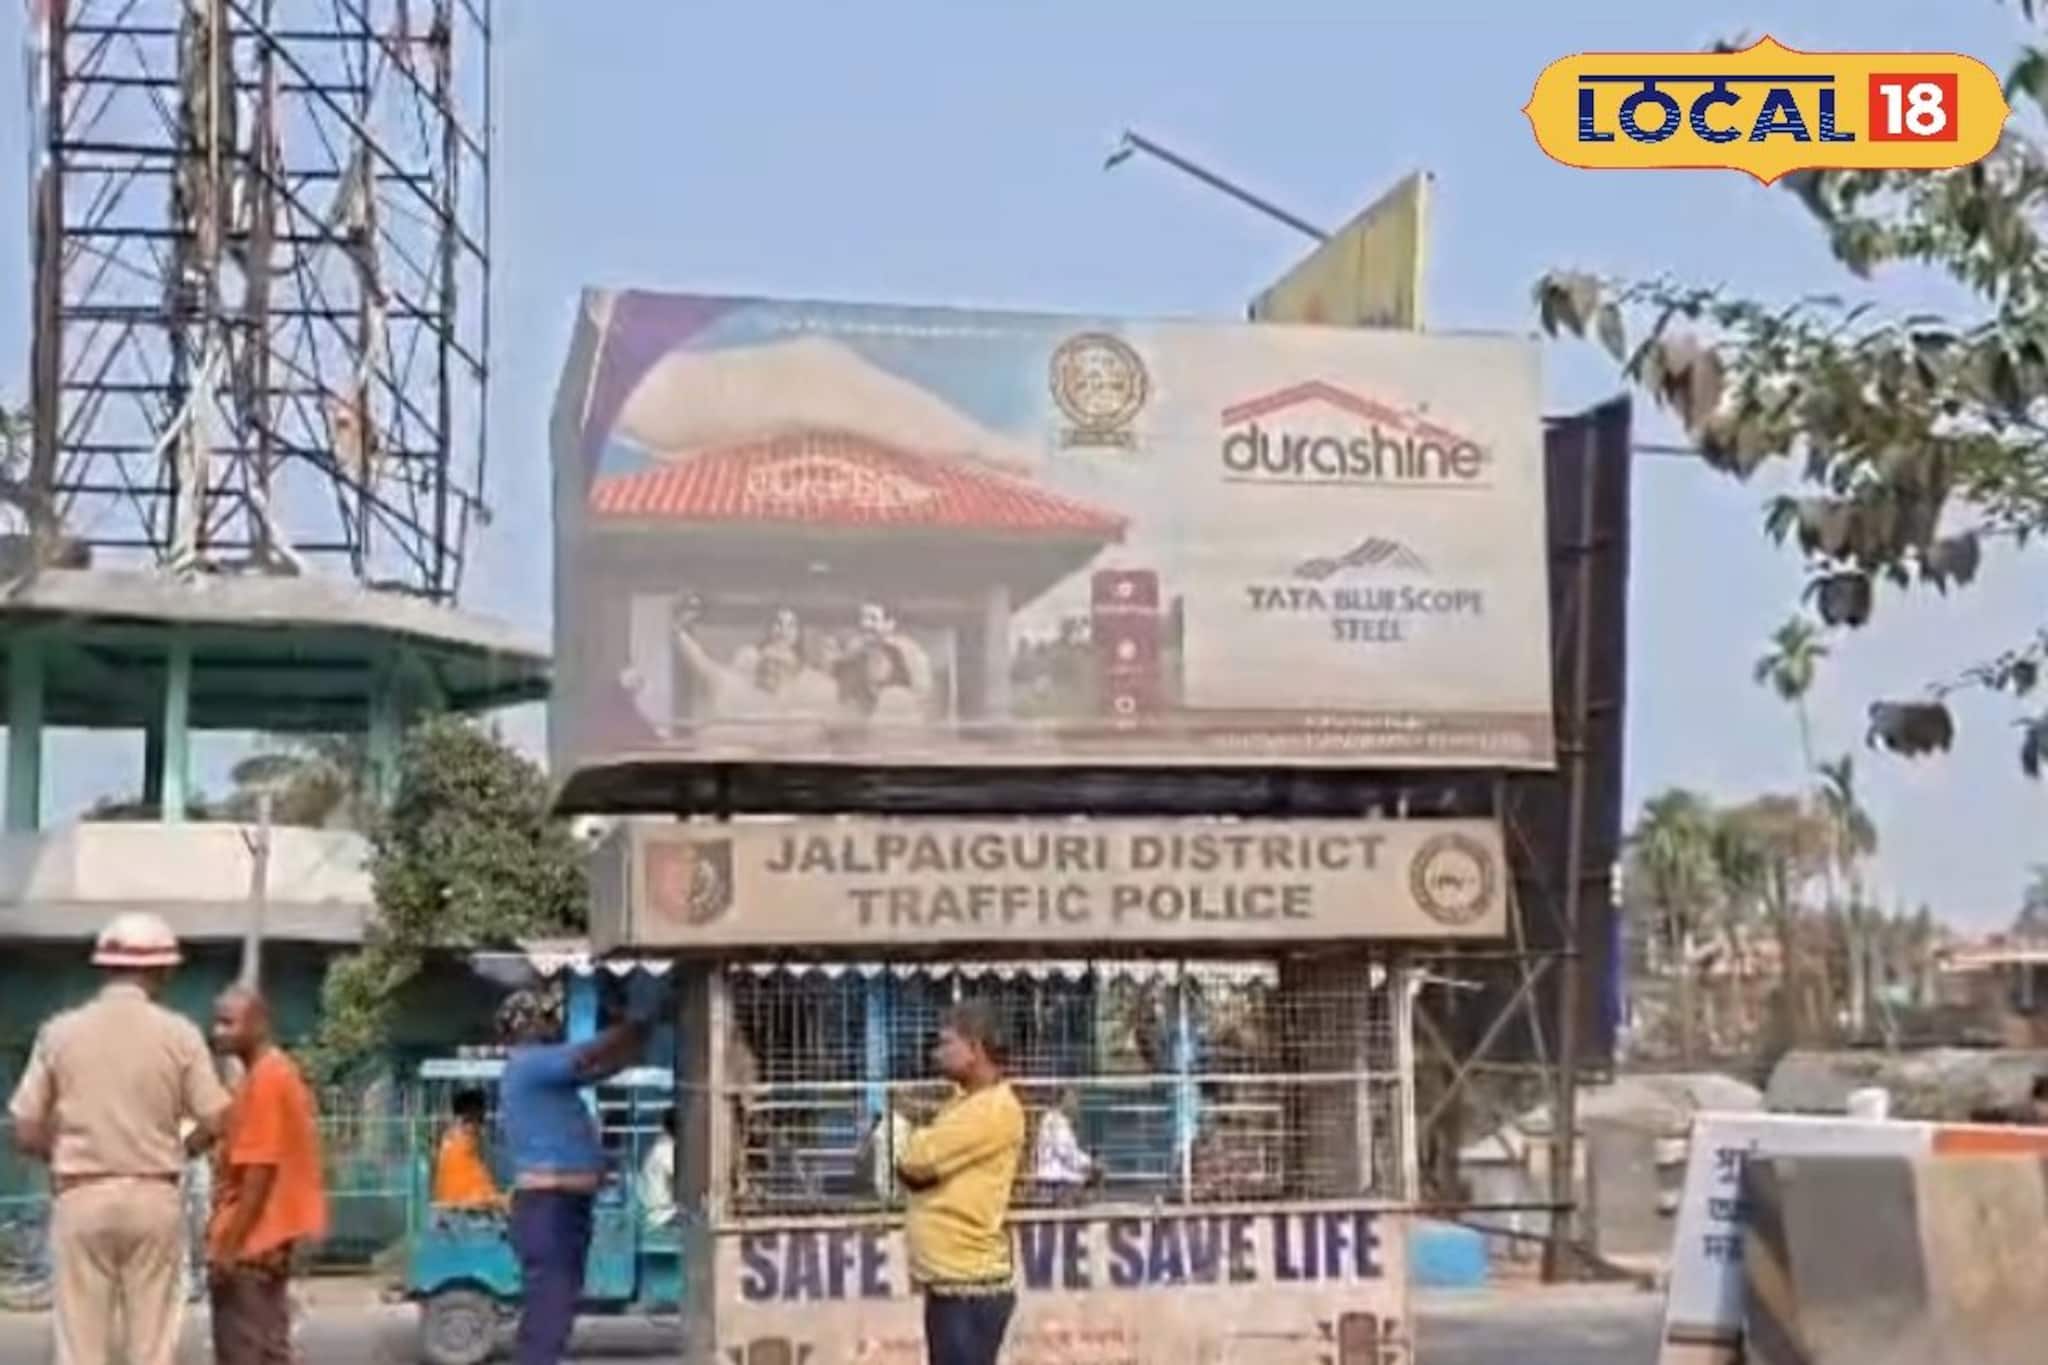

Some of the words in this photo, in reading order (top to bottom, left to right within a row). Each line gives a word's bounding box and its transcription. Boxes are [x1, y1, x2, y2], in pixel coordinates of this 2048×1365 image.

[1222, 423, 1482, 478] durashine
[1247, 586, 1327, 611] TATA
[1331, 618, 1402, 642] STEEL
[765, 834, 1107, 873] JALPAIGURI
[1129, 834, 1385, 871] DISTRICT
[848, 884, 1091, 925] TRAFFIC
[1111, 883, 1312, 921] POLICE
[741, 1228, 891, 1300] SAFE
[1108, 1215, 1257, 1287] SAVE
[1273, 1210, 1382, 1280] LIFE
